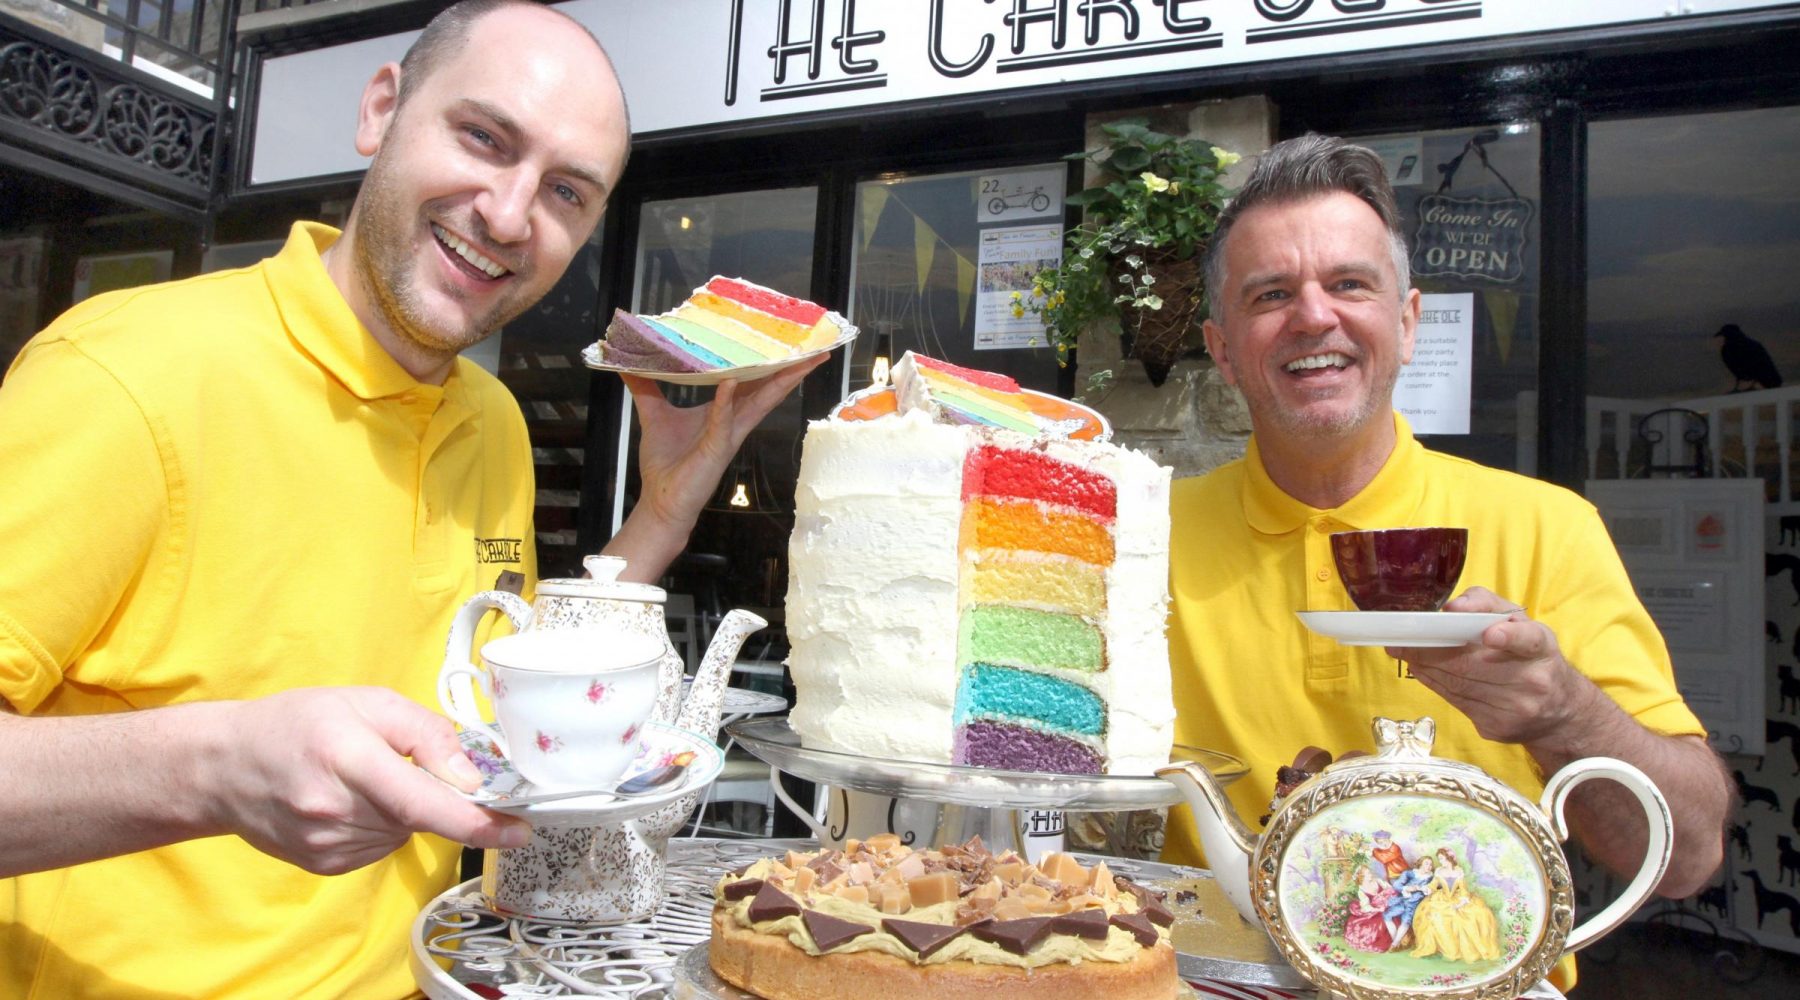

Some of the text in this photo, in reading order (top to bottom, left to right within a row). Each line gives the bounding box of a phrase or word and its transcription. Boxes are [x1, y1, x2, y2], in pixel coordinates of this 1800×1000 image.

[982, 179, 999, 194] 22
[1426, 205, 1518, 228] Come In
[1426, 247, 1509, 272] OPEN
